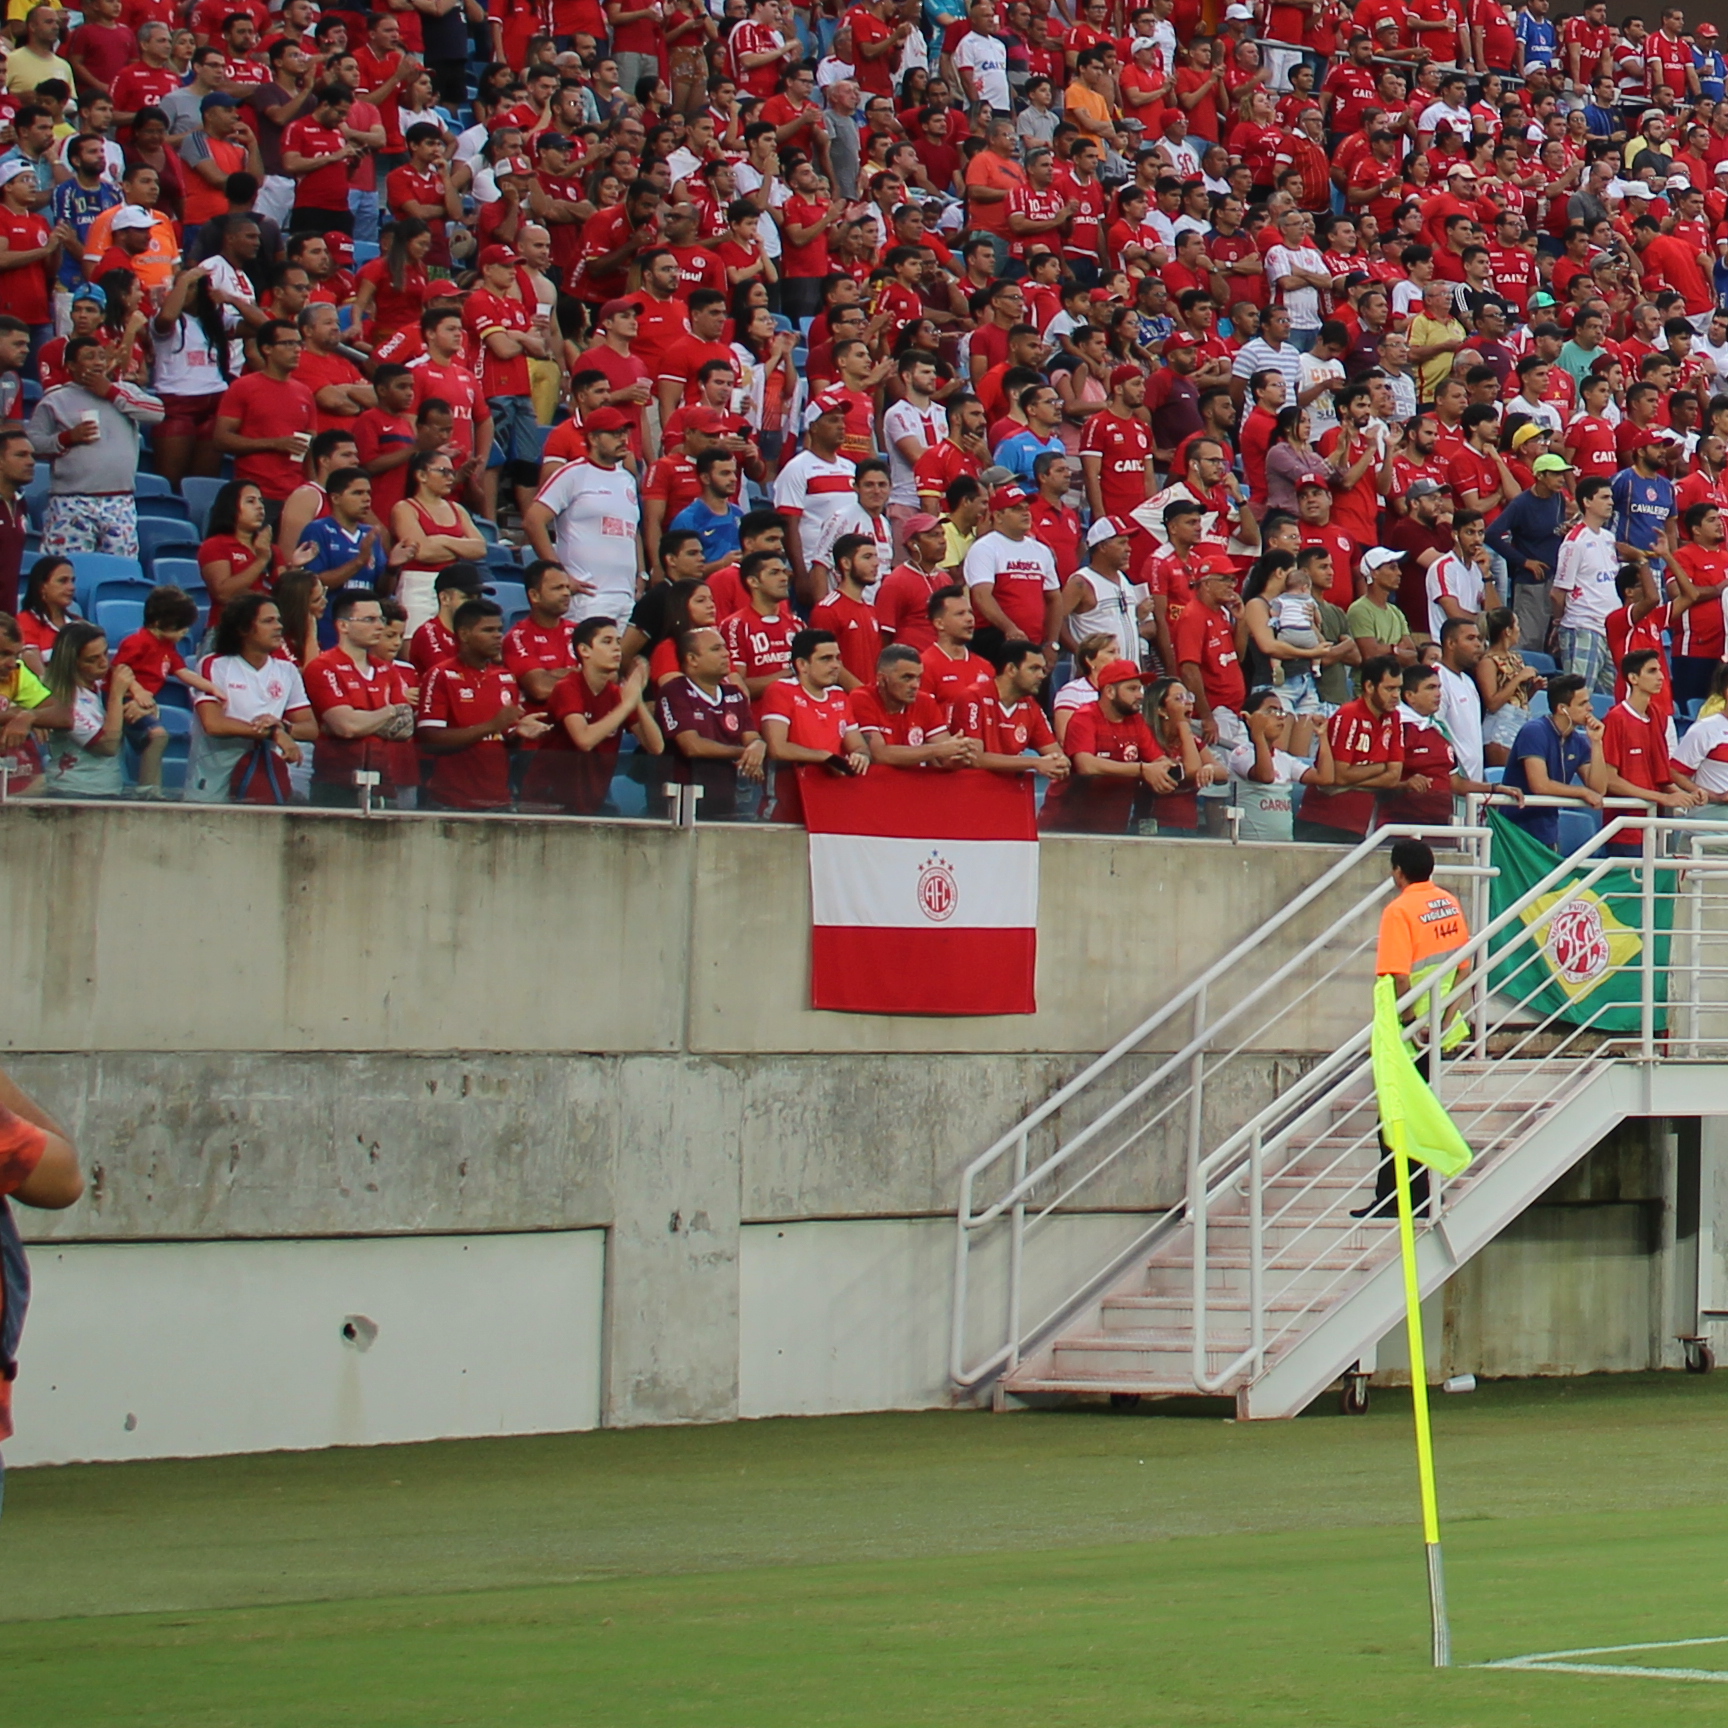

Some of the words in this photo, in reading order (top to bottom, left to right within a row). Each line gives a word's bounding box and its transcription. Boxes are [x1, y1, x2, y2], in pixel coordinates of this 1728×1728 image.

[1029, 199, 1041, 213] 10
[1495, 273, 1529, 284] CAIXA
[750, 631, 770, 654] 10
[924, 876, 951, 912] AFC
[1434, 921, 1459, 940] 1444
